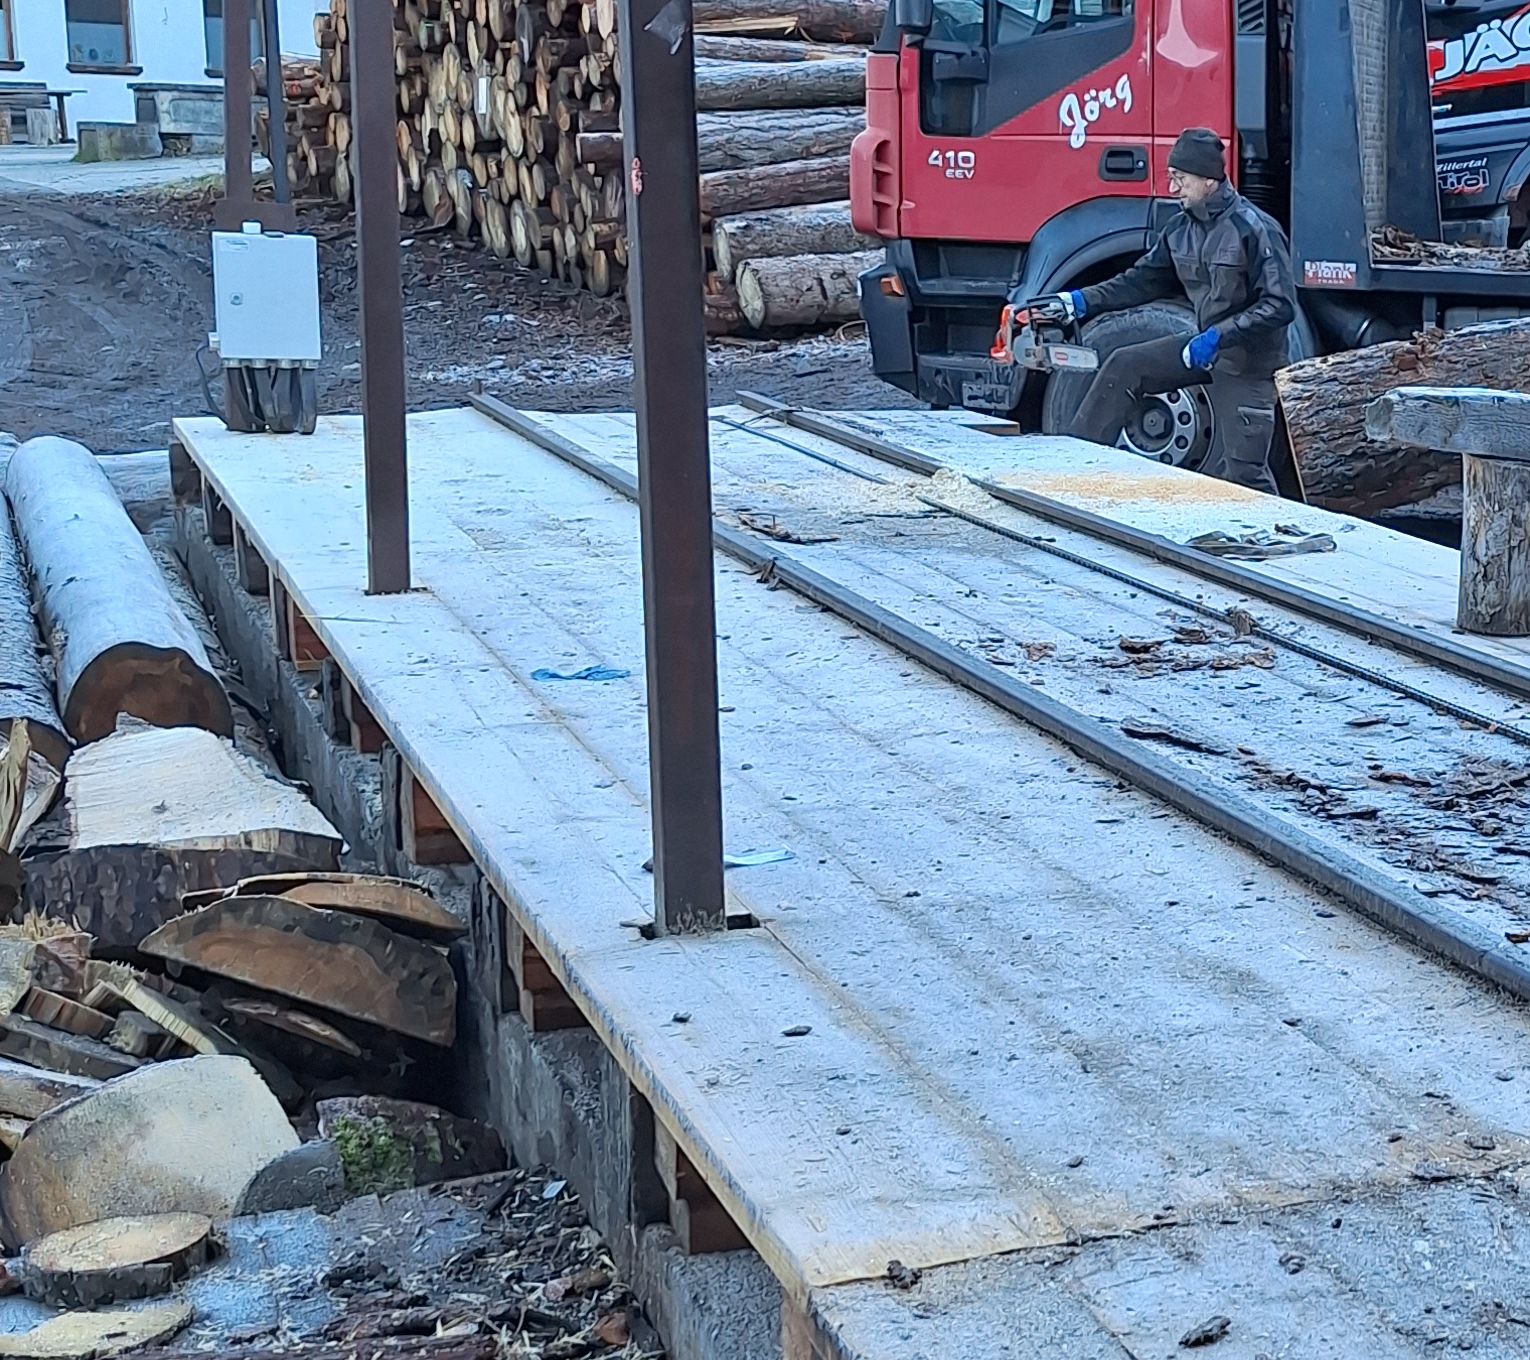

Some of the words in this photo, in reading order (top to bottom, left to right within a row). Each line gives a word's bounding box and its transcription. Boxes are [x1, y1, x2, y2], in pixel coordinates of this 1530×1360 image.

[1059, 73, 1133, 148] Jörg
[927, 150, 976, 169] 410
[1437, 157, 1488, 172] Zillertal
[945, 169, 975, 180] EEV
[1305, 260, 1354, 280] Plank
